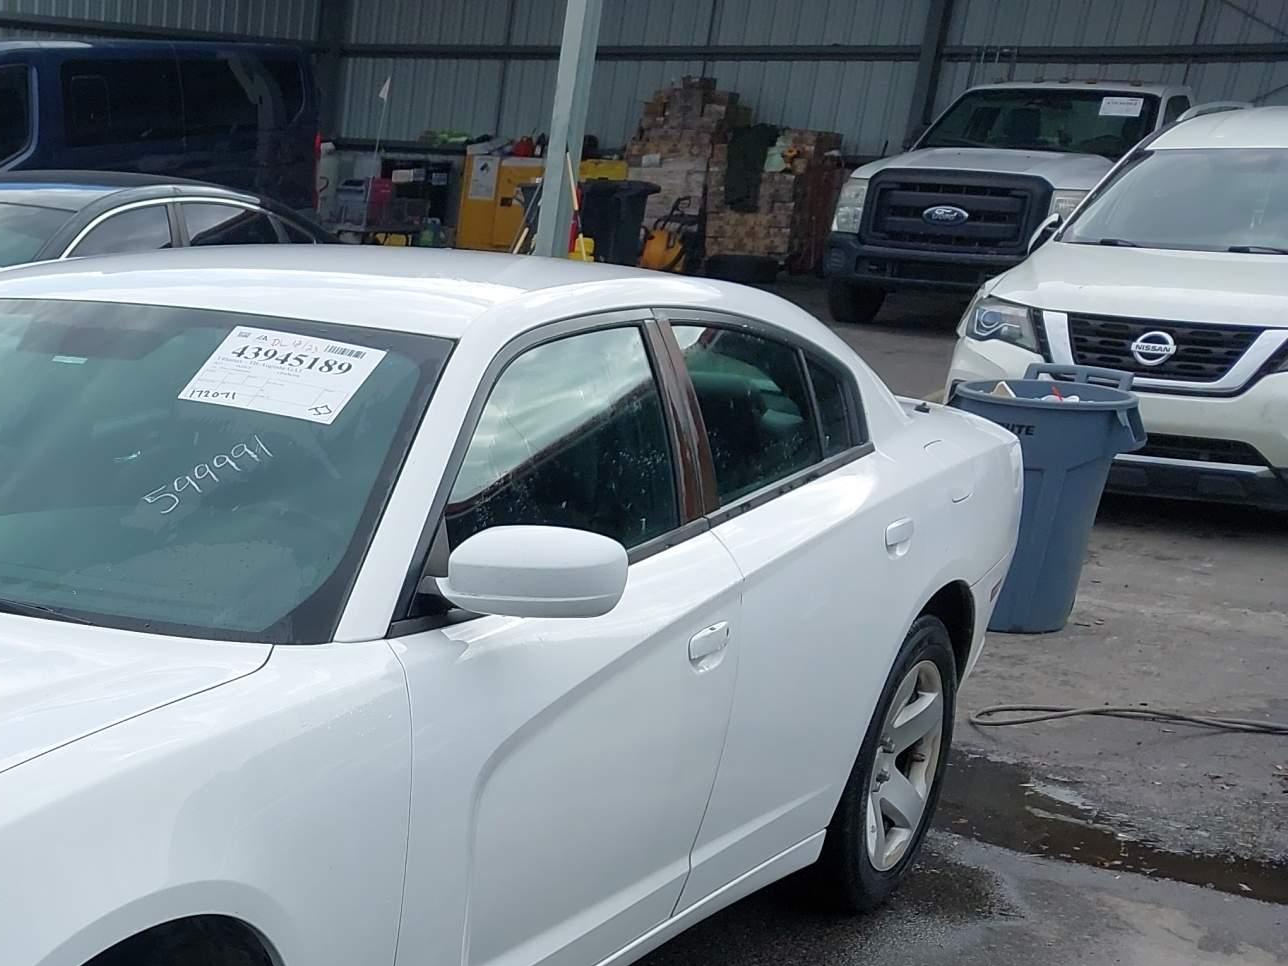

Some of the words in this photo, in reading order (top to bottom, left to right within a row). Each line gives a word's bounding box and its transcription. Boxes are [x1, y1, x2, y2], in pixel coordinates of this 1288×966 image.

[231, 344, 353, 375] 43945189
[1135, 344, 1171, 353] NISSAN
[143, 434, 272, 514] 599991
